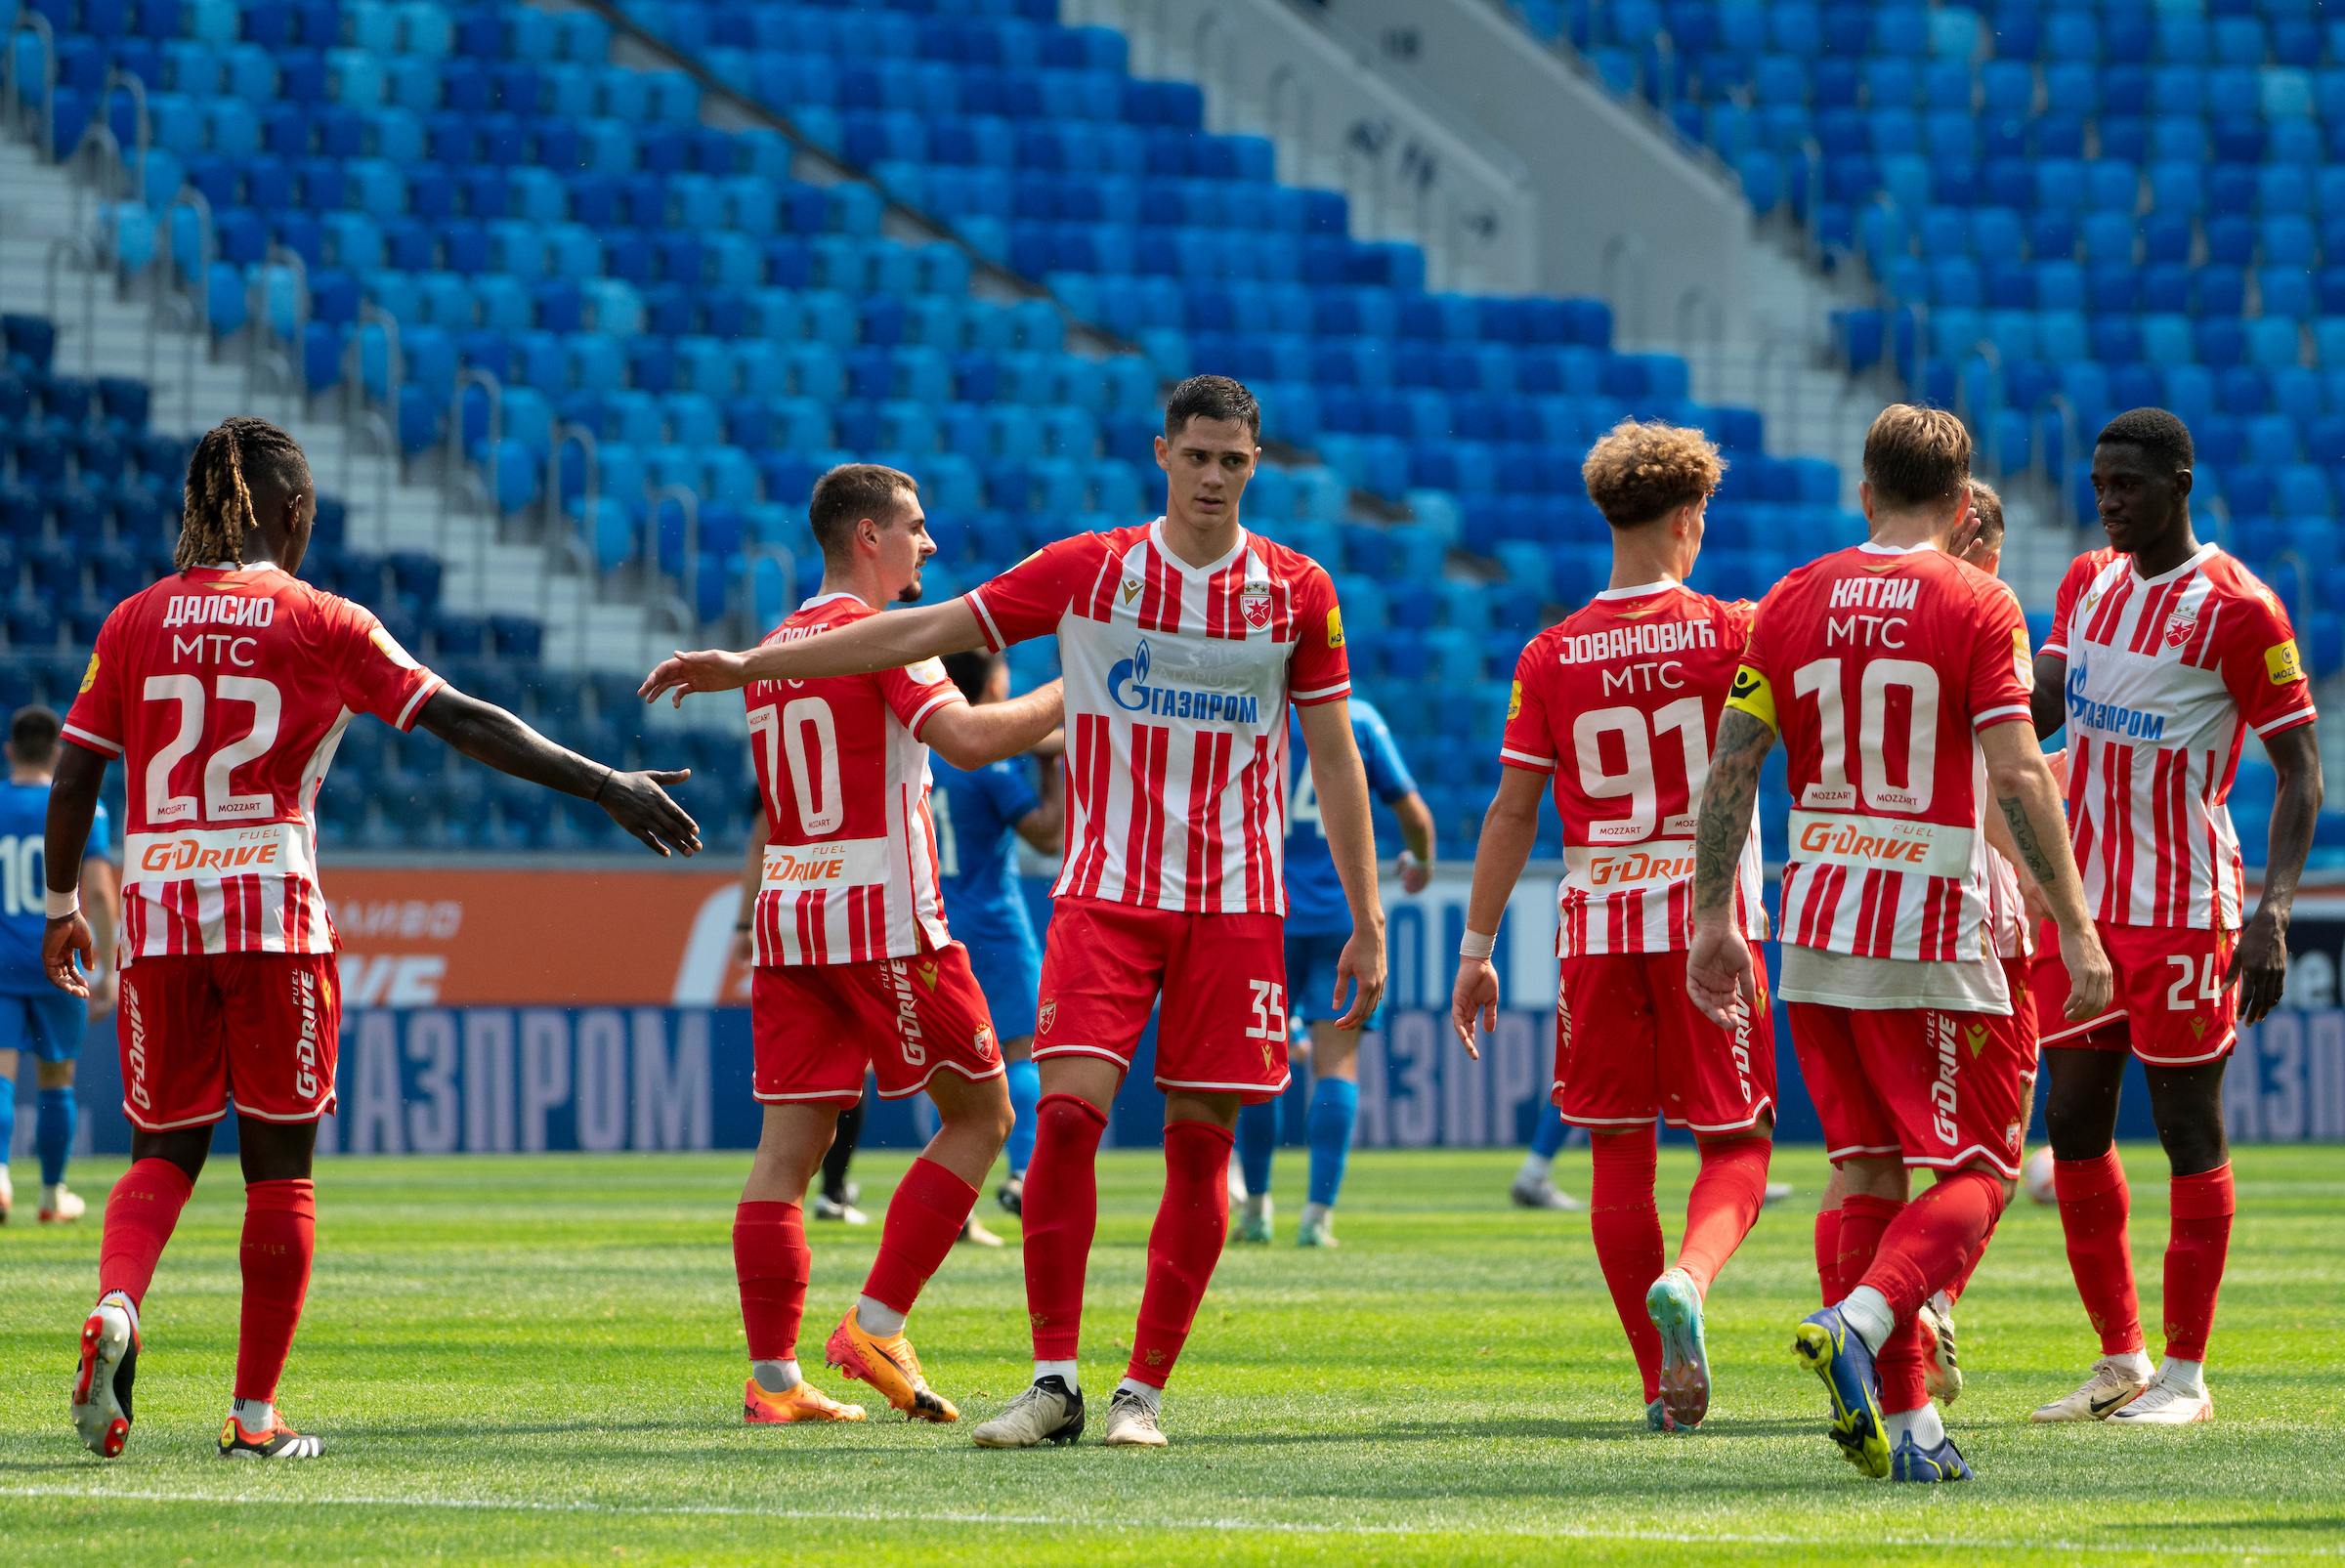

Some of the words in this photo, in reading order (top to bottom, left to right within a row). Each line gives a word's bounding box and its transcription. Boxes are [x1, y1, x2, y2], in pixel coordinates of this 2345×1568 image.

[163, 595, 275, 628] ДАЛСИО
[1829, 577, 1919, 611] КАТАИ
[1559, 618, 1716, 665] ЈОВАНОВИЋ
[1151, 687, 1258, 723] ГАЗПРОМ
[143, 673, 282, 826] 22
[1794, 657, 1940, 815] 10
[746, 697, 844, 836] 70
[1572, 696, 1710, 842] 91
[218, 802, 261, 813] MOZZART
[1811, 790, 1852, 801] MOZZART
[1876, 792, 1919, 806] MOZZART
[239, 828, 281, 841] FUEL
[1599, 826, 1642, 835] MOZZART
[1892, 824, 1935, 837] FUEL
[812, 845, 846, 856] FUEL
[0, 833, 46, 916] 10
[2166, 953, 2222, 1011] 24
[1246, 979, 1286, 1041] 35
